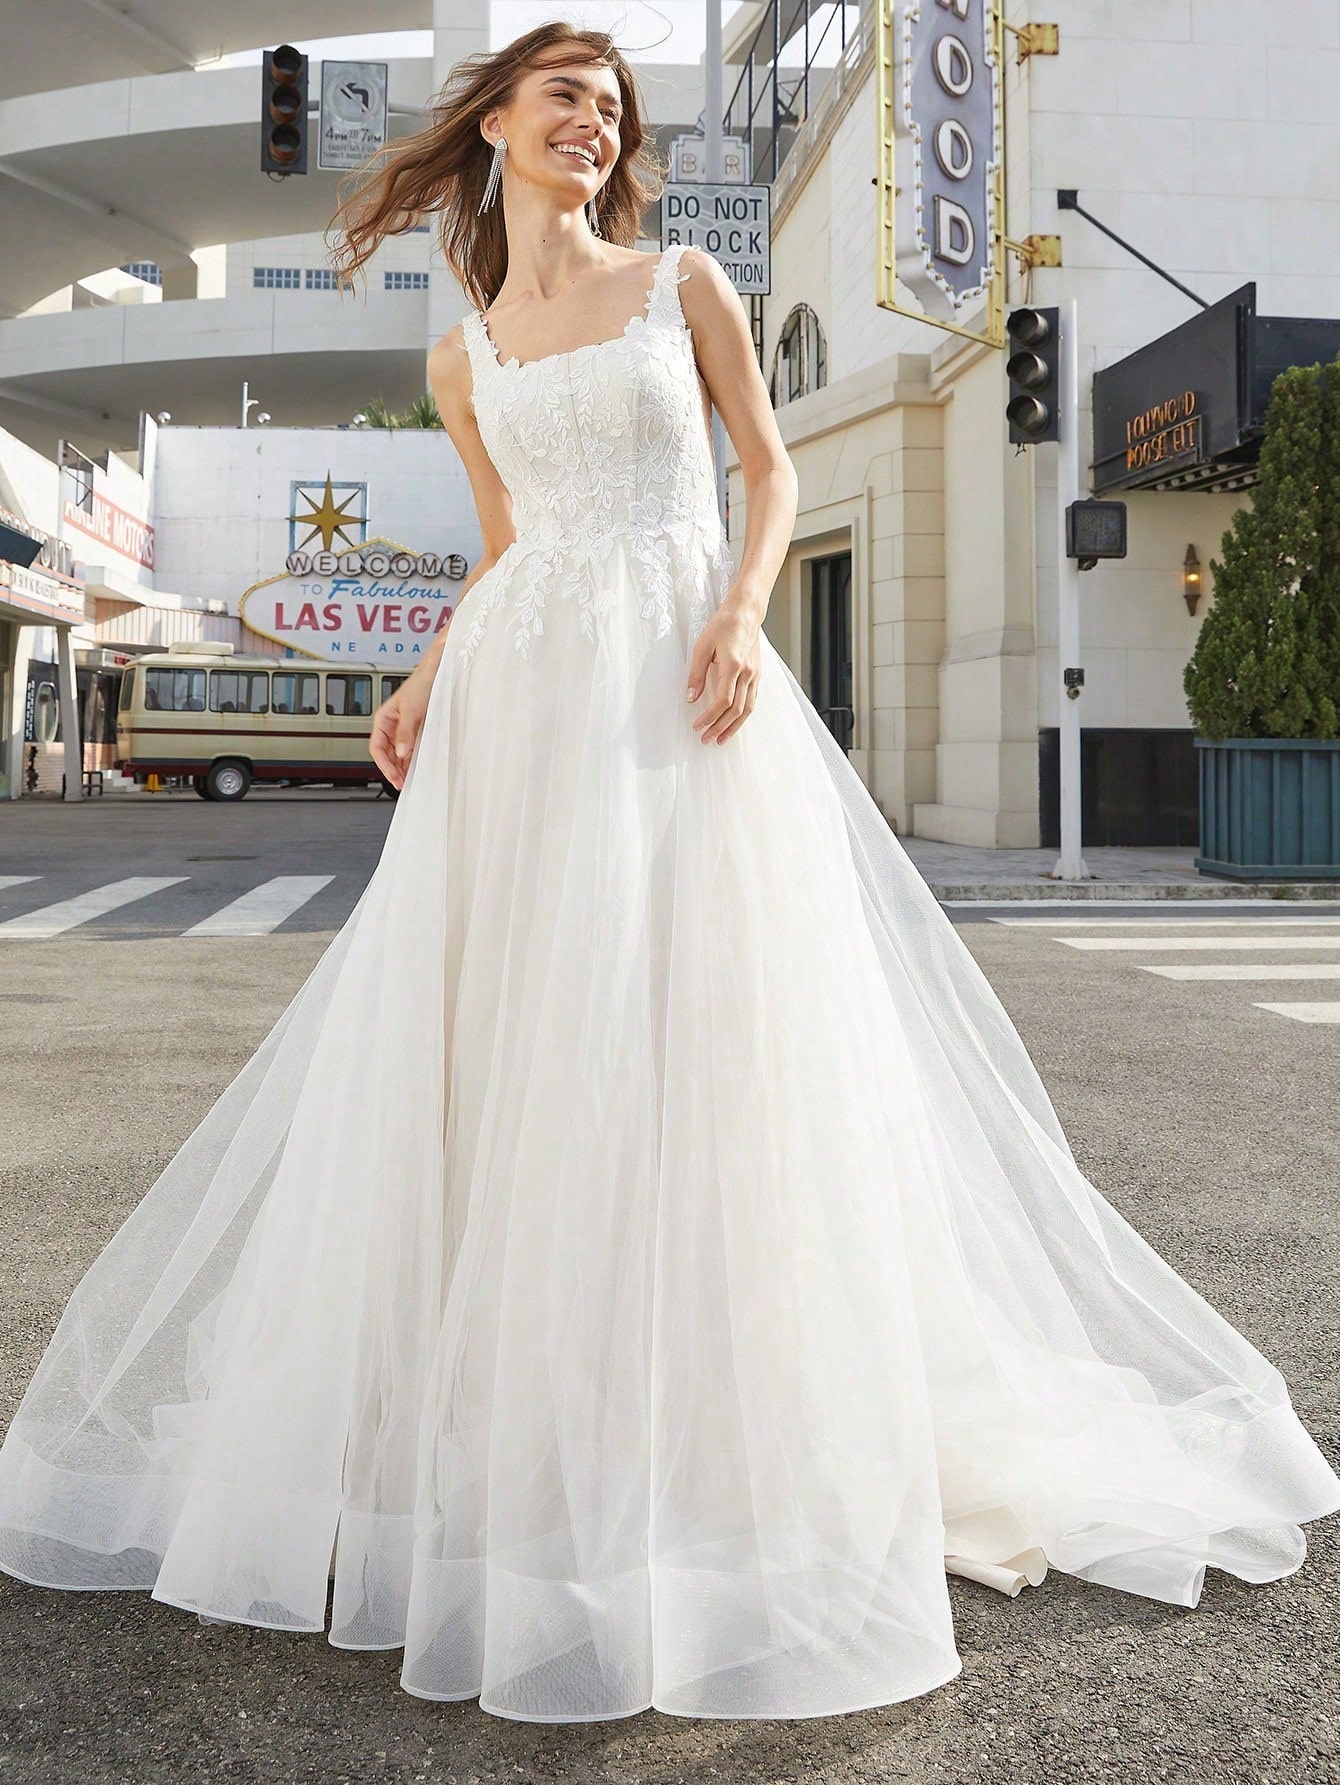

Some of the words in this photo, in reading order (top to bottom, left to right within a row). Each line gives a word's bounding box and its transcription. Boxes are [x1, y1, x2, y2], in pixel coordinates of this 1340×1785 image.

[325, 126, 348, 141] 4PM
[361, 128, 382, 142] 7PM
[681, 153, 741, 175] BR
[668, 195, 700, 219] DO
[714, 197, 763, 221] NOT
[668, 228, 762, 254] BLOCK
[288, 554, 463, 577] WELCOME
[300, 584, 323, 595] TO
[328, 578, 449, 600] Fabulous
[275, 602, 342, 631] LAS
[356, 604, 455, 634] VEGA
